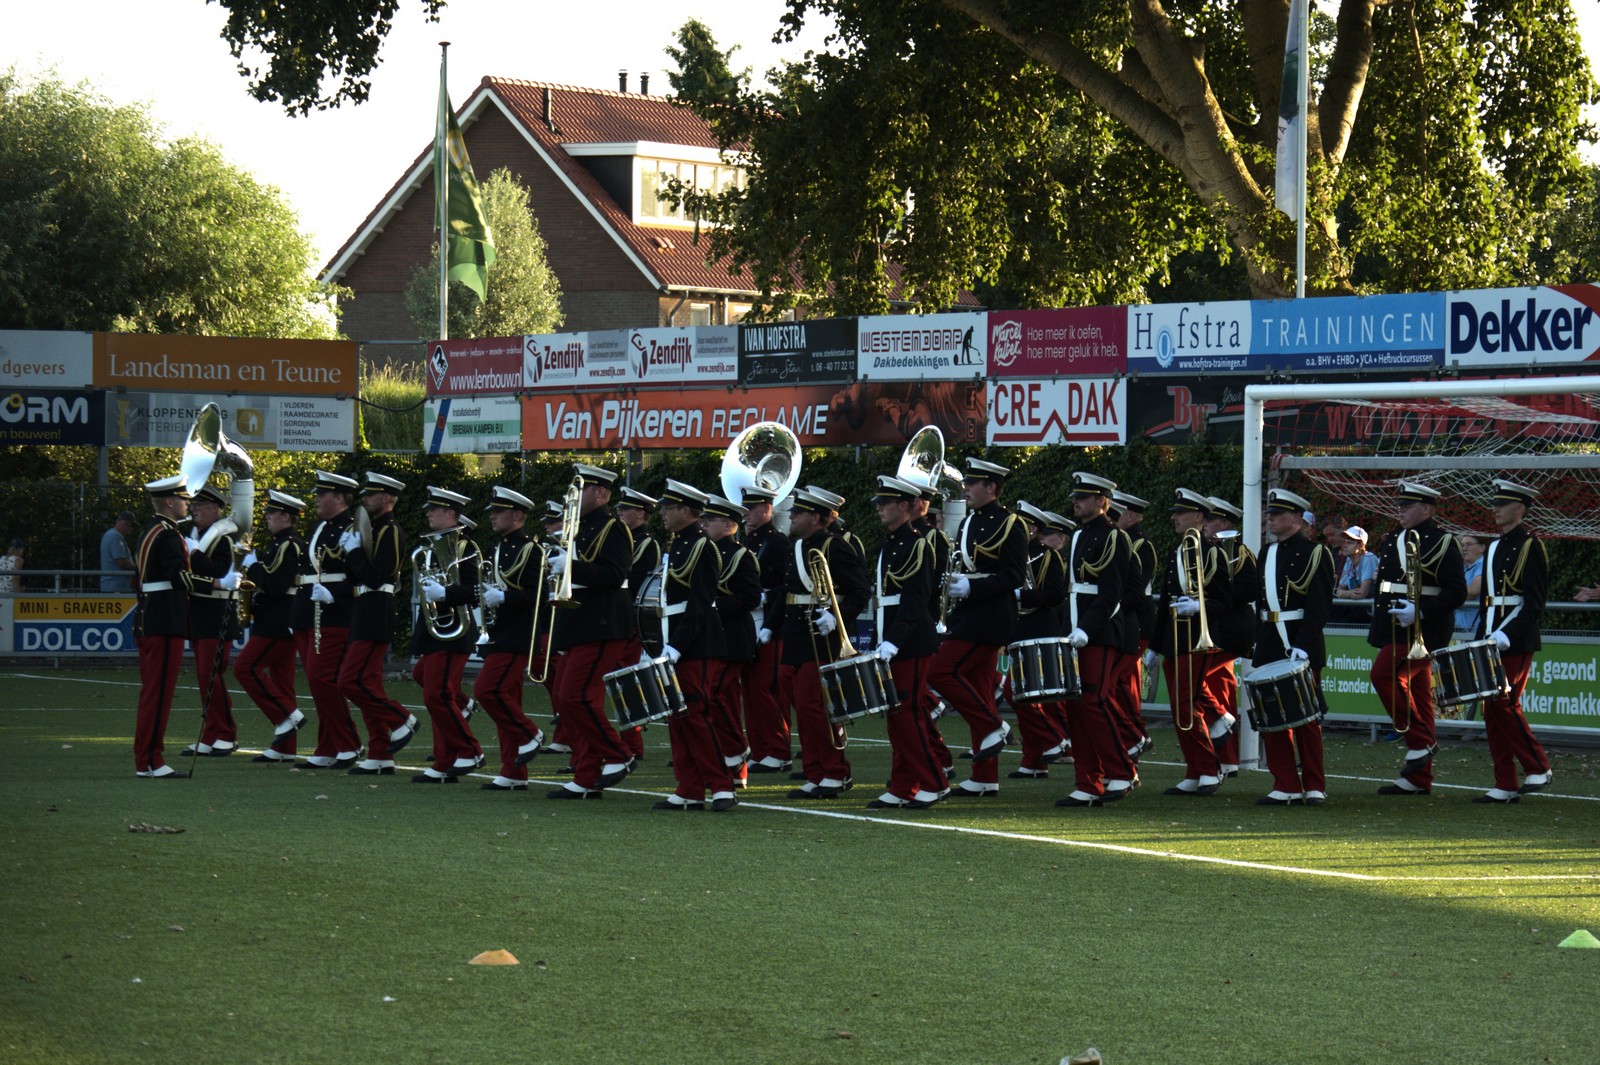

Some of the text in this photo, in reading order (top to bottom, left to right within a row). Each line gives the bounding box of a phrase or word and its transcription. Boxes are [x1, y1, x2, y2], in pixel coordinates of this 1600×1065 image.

[992, 321, 1022, 344] Marcel
[1027, 324, 1103, 341] Hoe meer ik oefen,
[1135, 307, 1240, 361] Hofstra
[1262, 312, 1434, 346] TRAININGEN
[1451, 298, 1593, 354] Dekker
[745, 325, 807, 351] IVAN HOFSTRA
[860, 329, 963, 352] WESTENDORP
[544, 343, 584, 377] Zendijk
[650, 337, 692, 373] Zendijk
[1027, 340, 1120, 363] hoe meer geluk ik heb.
[1306, 358, 1317, 366] o.a.
[1318, 355, 1331, 366] BHV
[1336, 354, 1355, 366] EHBO
[2, 359, 65, 377] dgevers
[109, 354, 341, 383] Landsman en Teune
[697, 362, 735, 375] www.zendijk.com
[816, 362, 822, 371] 06
[826, 361, 833, 371] 40
[834, 361, 841, 370] 77
[841, 360, 847, 370] 22
[873, 354, 950, 369] Dakbedekkingen
[589, 366, 626, 378] www.zendijk.com
[137, 407, 228, 419] KLOPPENG
[995, 382, 1118, 427] CRE DAK
[283, 411, 339, 419] RAAMDECORATIE
[545, 402, 591, 440] Van
[600, 399, 702, 446] Pijkeren
[138, 422, 193, 433] INTERIEU
[283, 420, 321, 428] GORDIJNEN
[453, 424, 473, 435] BREMAN
[474, 424, 494, 434] KAMPEN
[10, 428, 61, 440] bouwen!
[283, 429, 312, 437] BEHANG
[283, 438, 348, 447] BUITENZONWERING
[20, 602, 49, 614] MINI
[63, 601, 122, 614] GRAVERS
[23, 628, 123, 650] DOLCO
[1326, 654, 1372, 671] 4 minuten
[1543, 657, 1596, 684] gezond
[1338, 678, 1371, 694] zonder
[1519, 689, 1554, 713] kker
